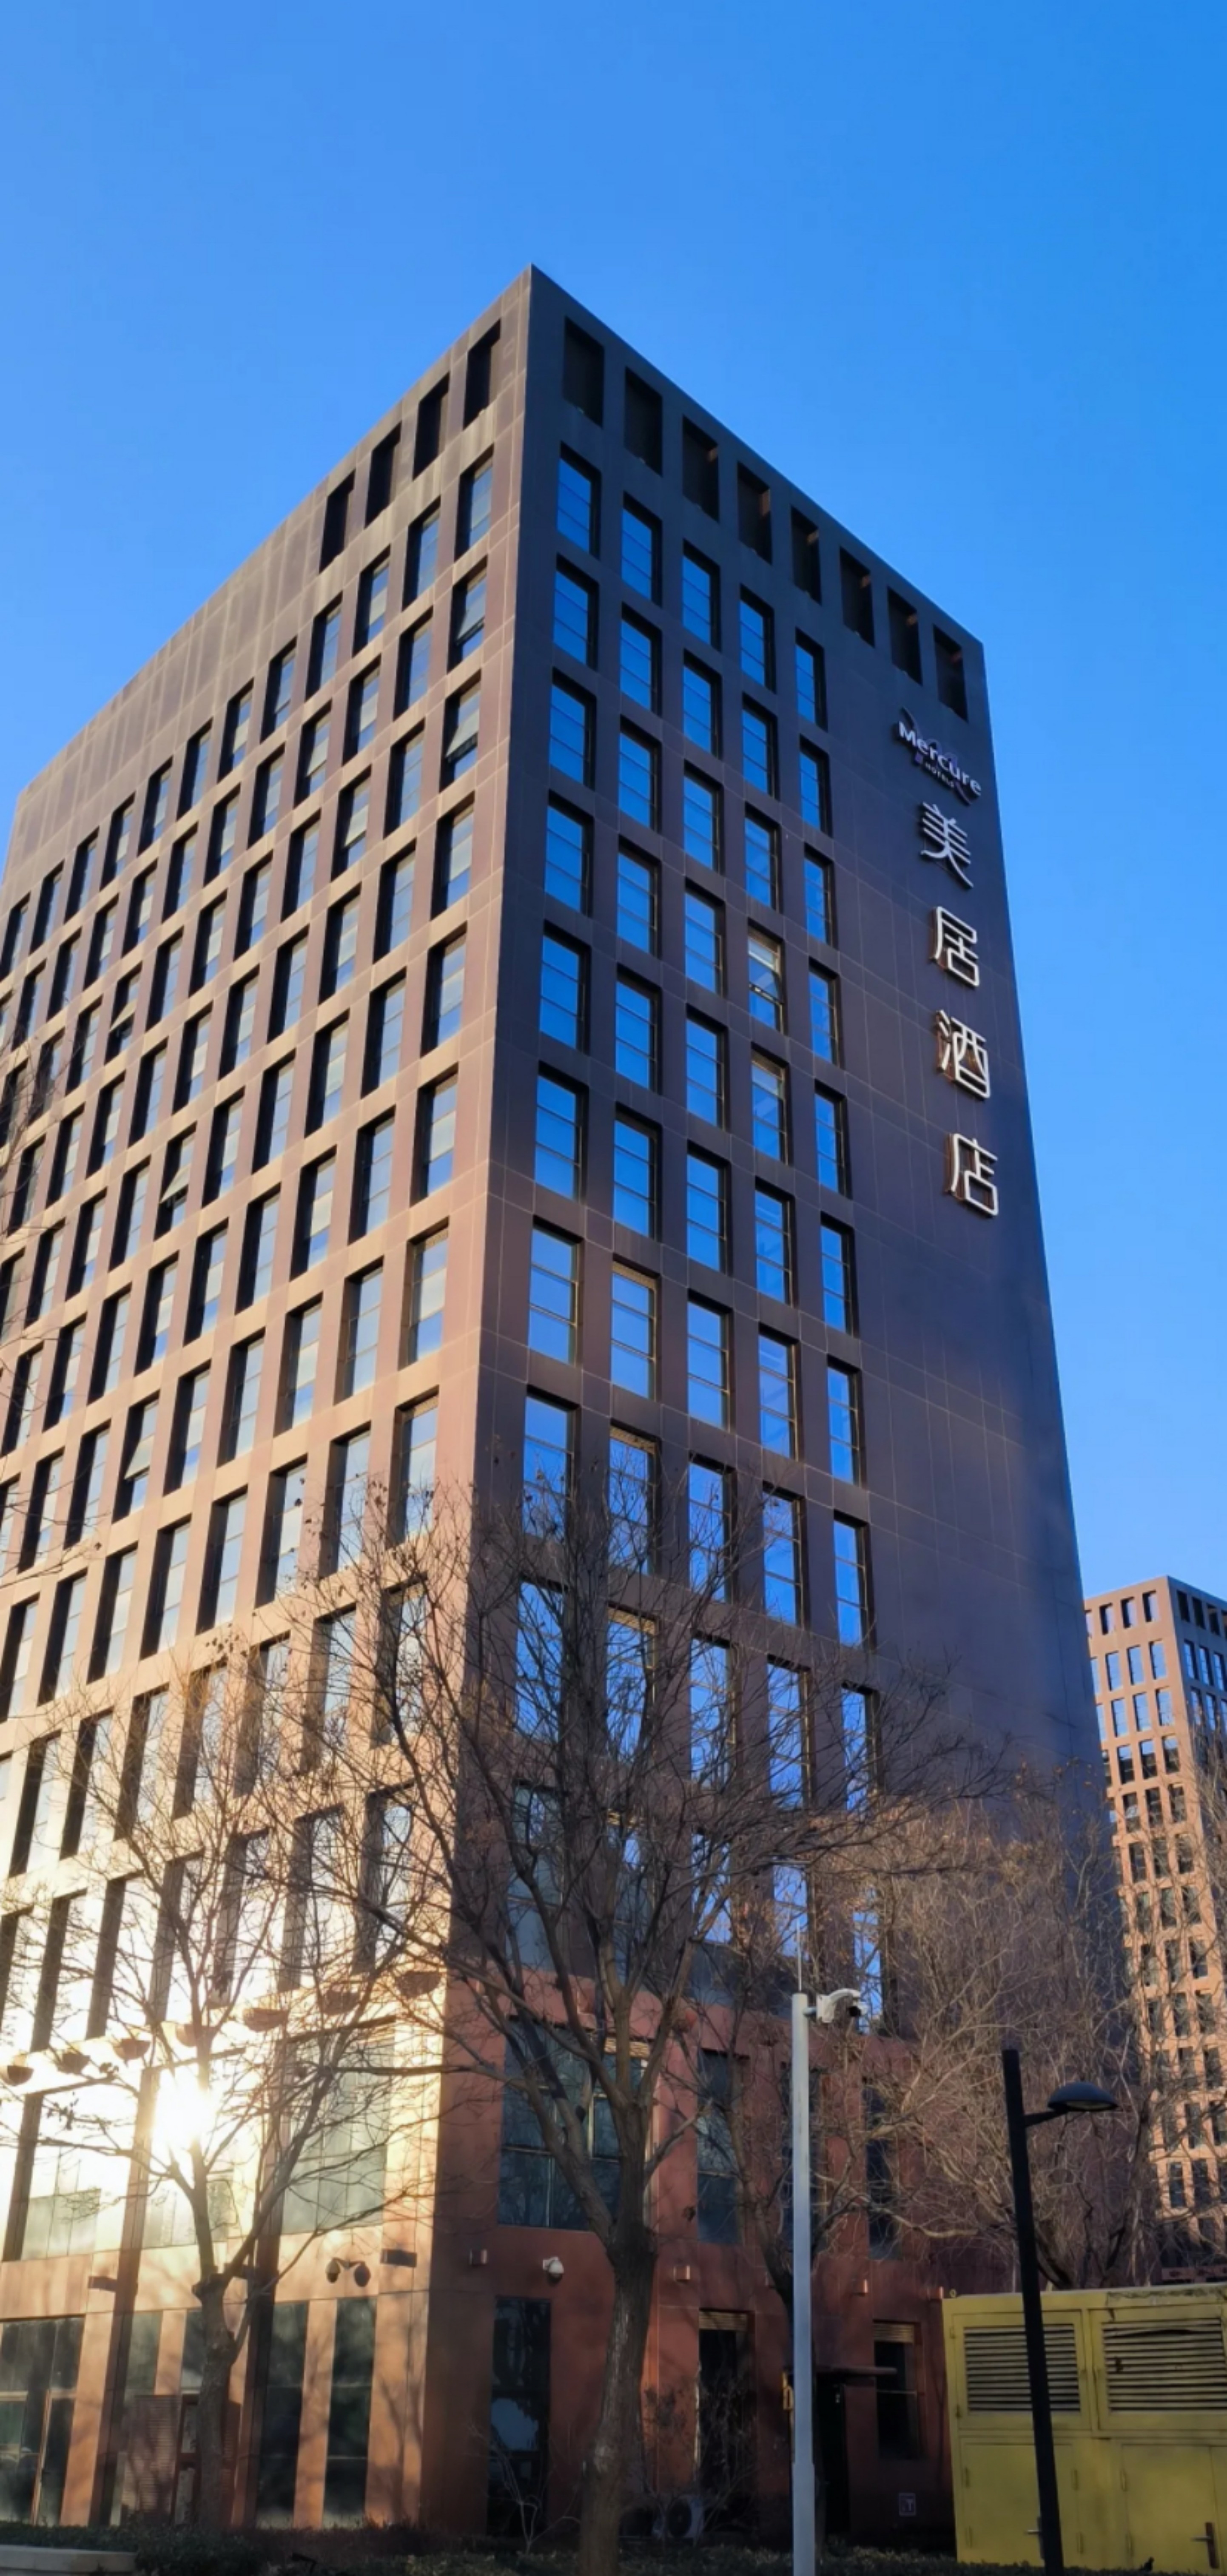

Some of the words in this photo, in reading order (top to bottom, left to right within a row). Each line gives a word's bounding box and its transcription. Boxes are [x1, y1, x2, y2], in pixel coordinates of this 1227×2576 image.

[898, 720, 982, 796] Mercure
[920, 801, 999, 1216] 美居酒店
